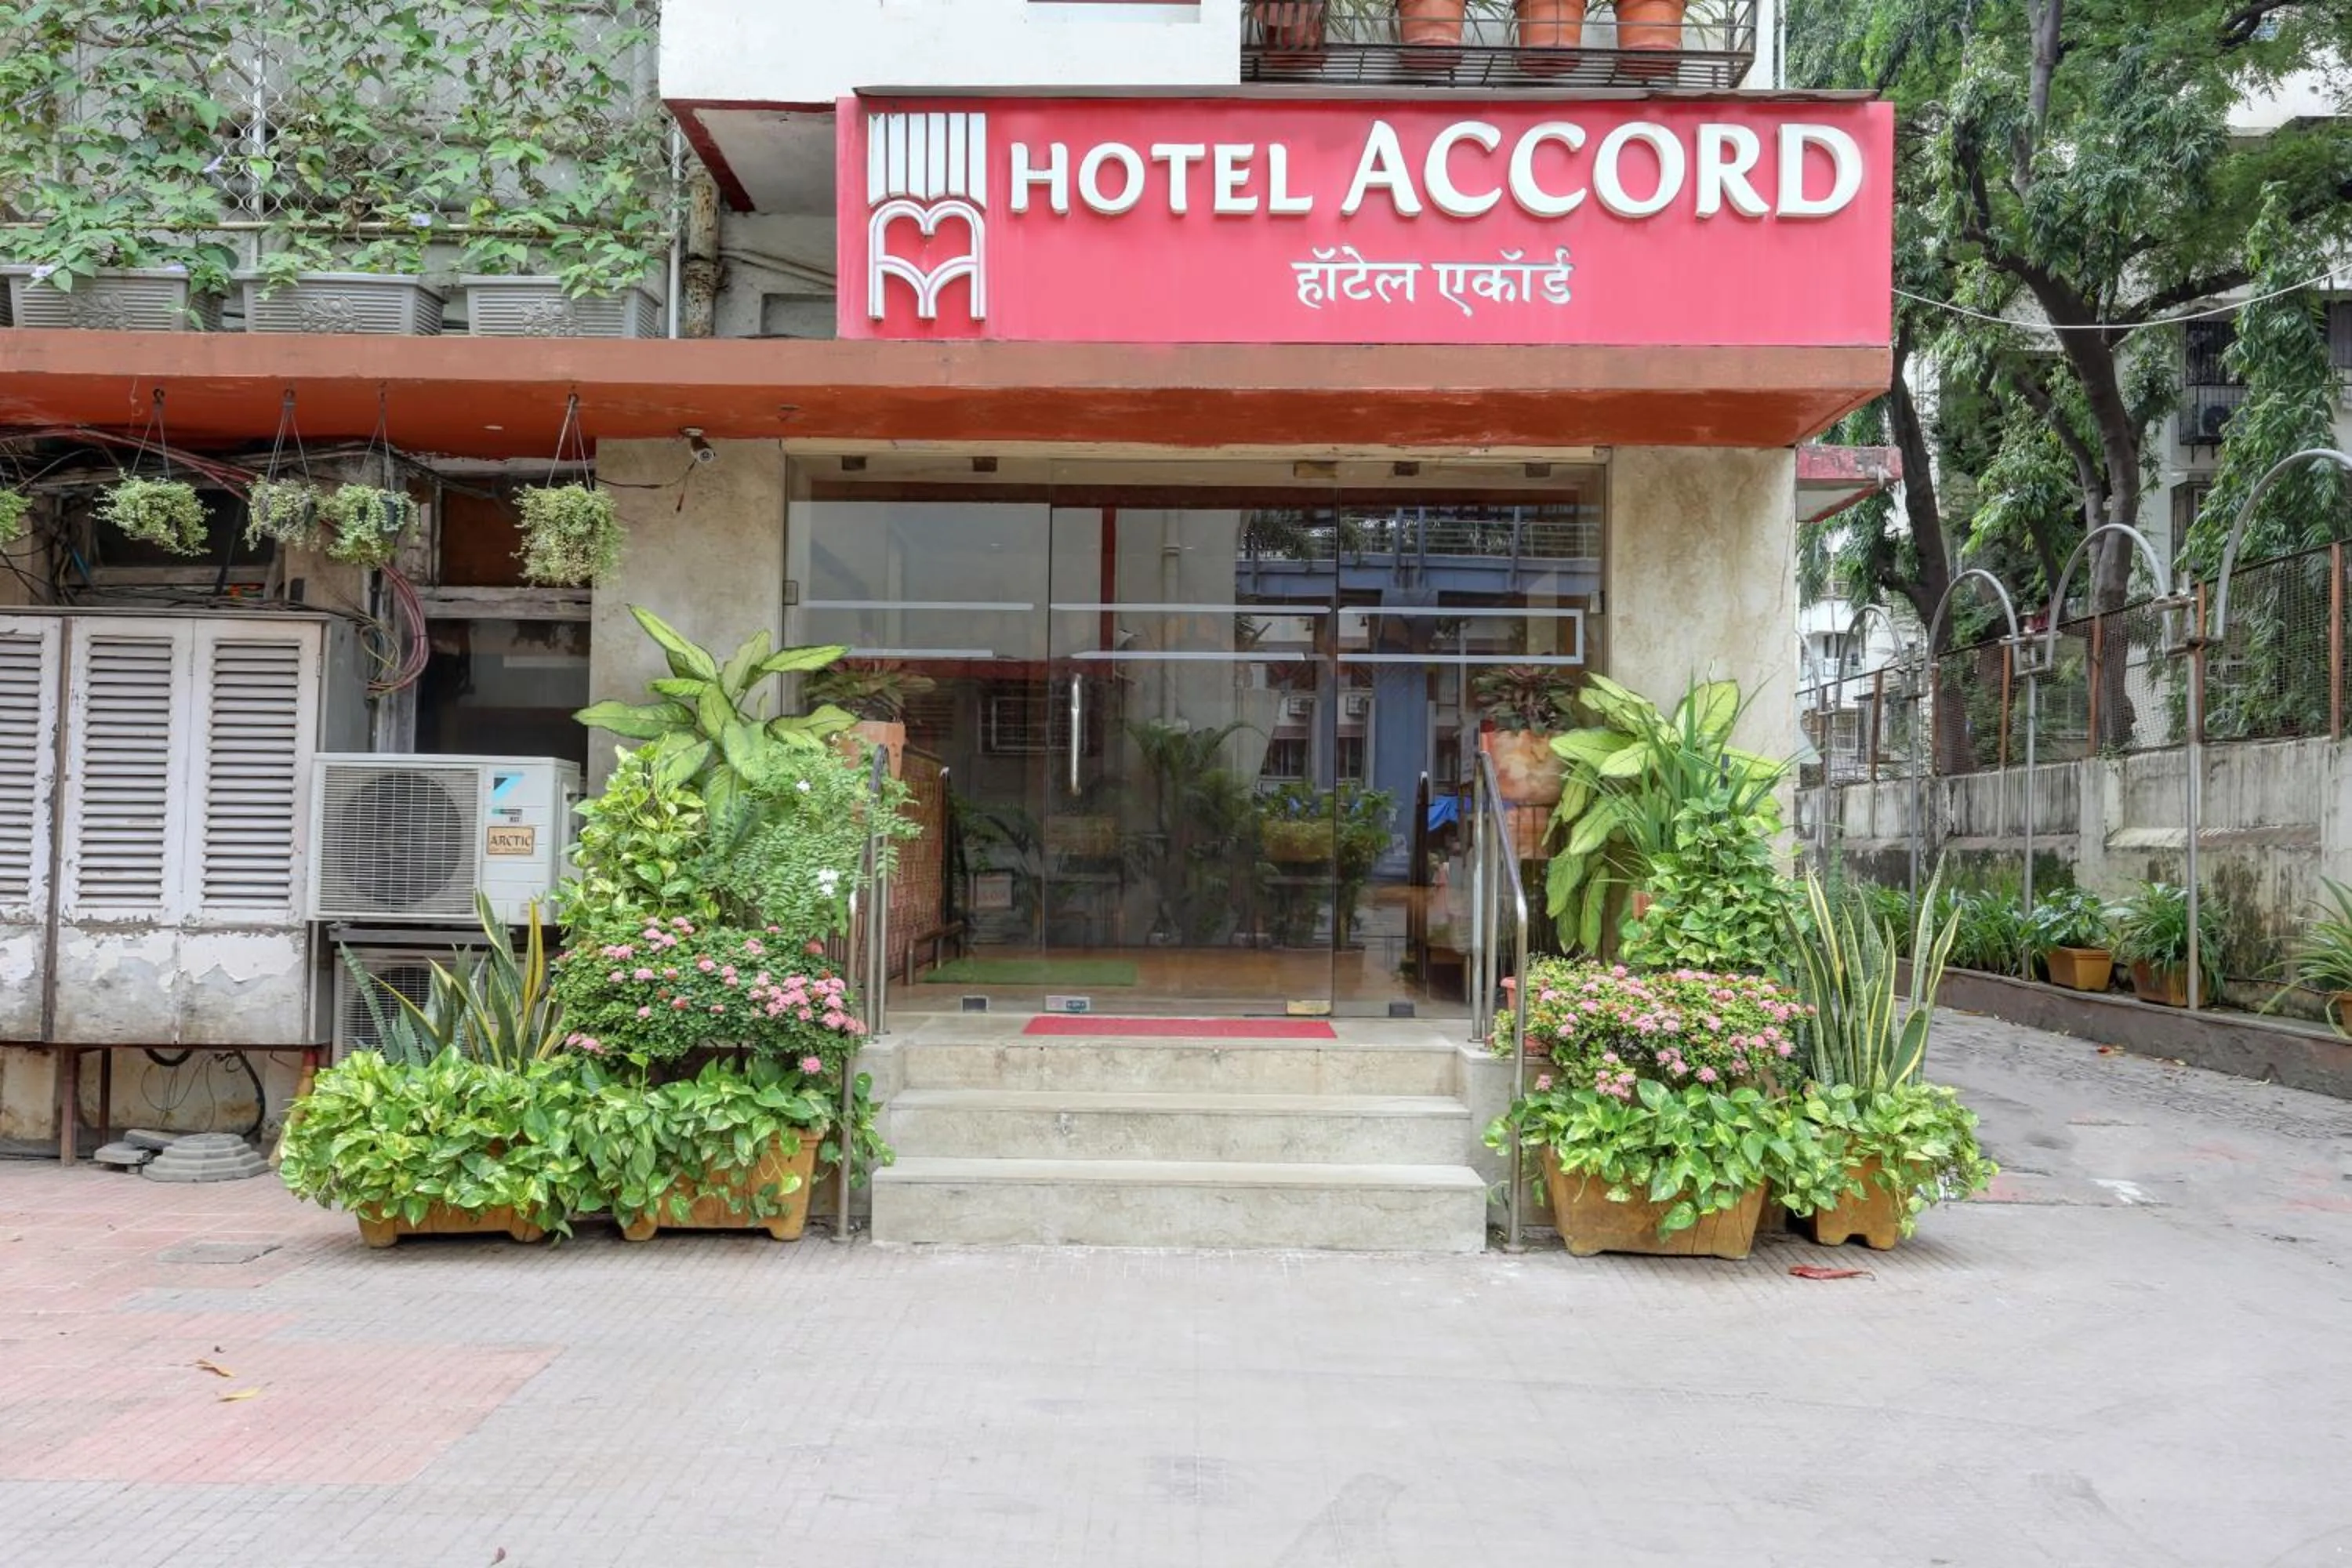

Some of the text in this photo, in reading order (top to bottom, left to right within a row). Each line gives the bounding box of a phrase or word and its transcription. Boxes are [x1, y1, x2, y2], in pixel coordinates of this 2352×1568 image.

[1009, 120, 1864, 219] HOTEL ACCORD
[1290, 245, 1574, 318] हॉटेल एकॉर्ड
[490, 835, 531, 847] ARCTIC
